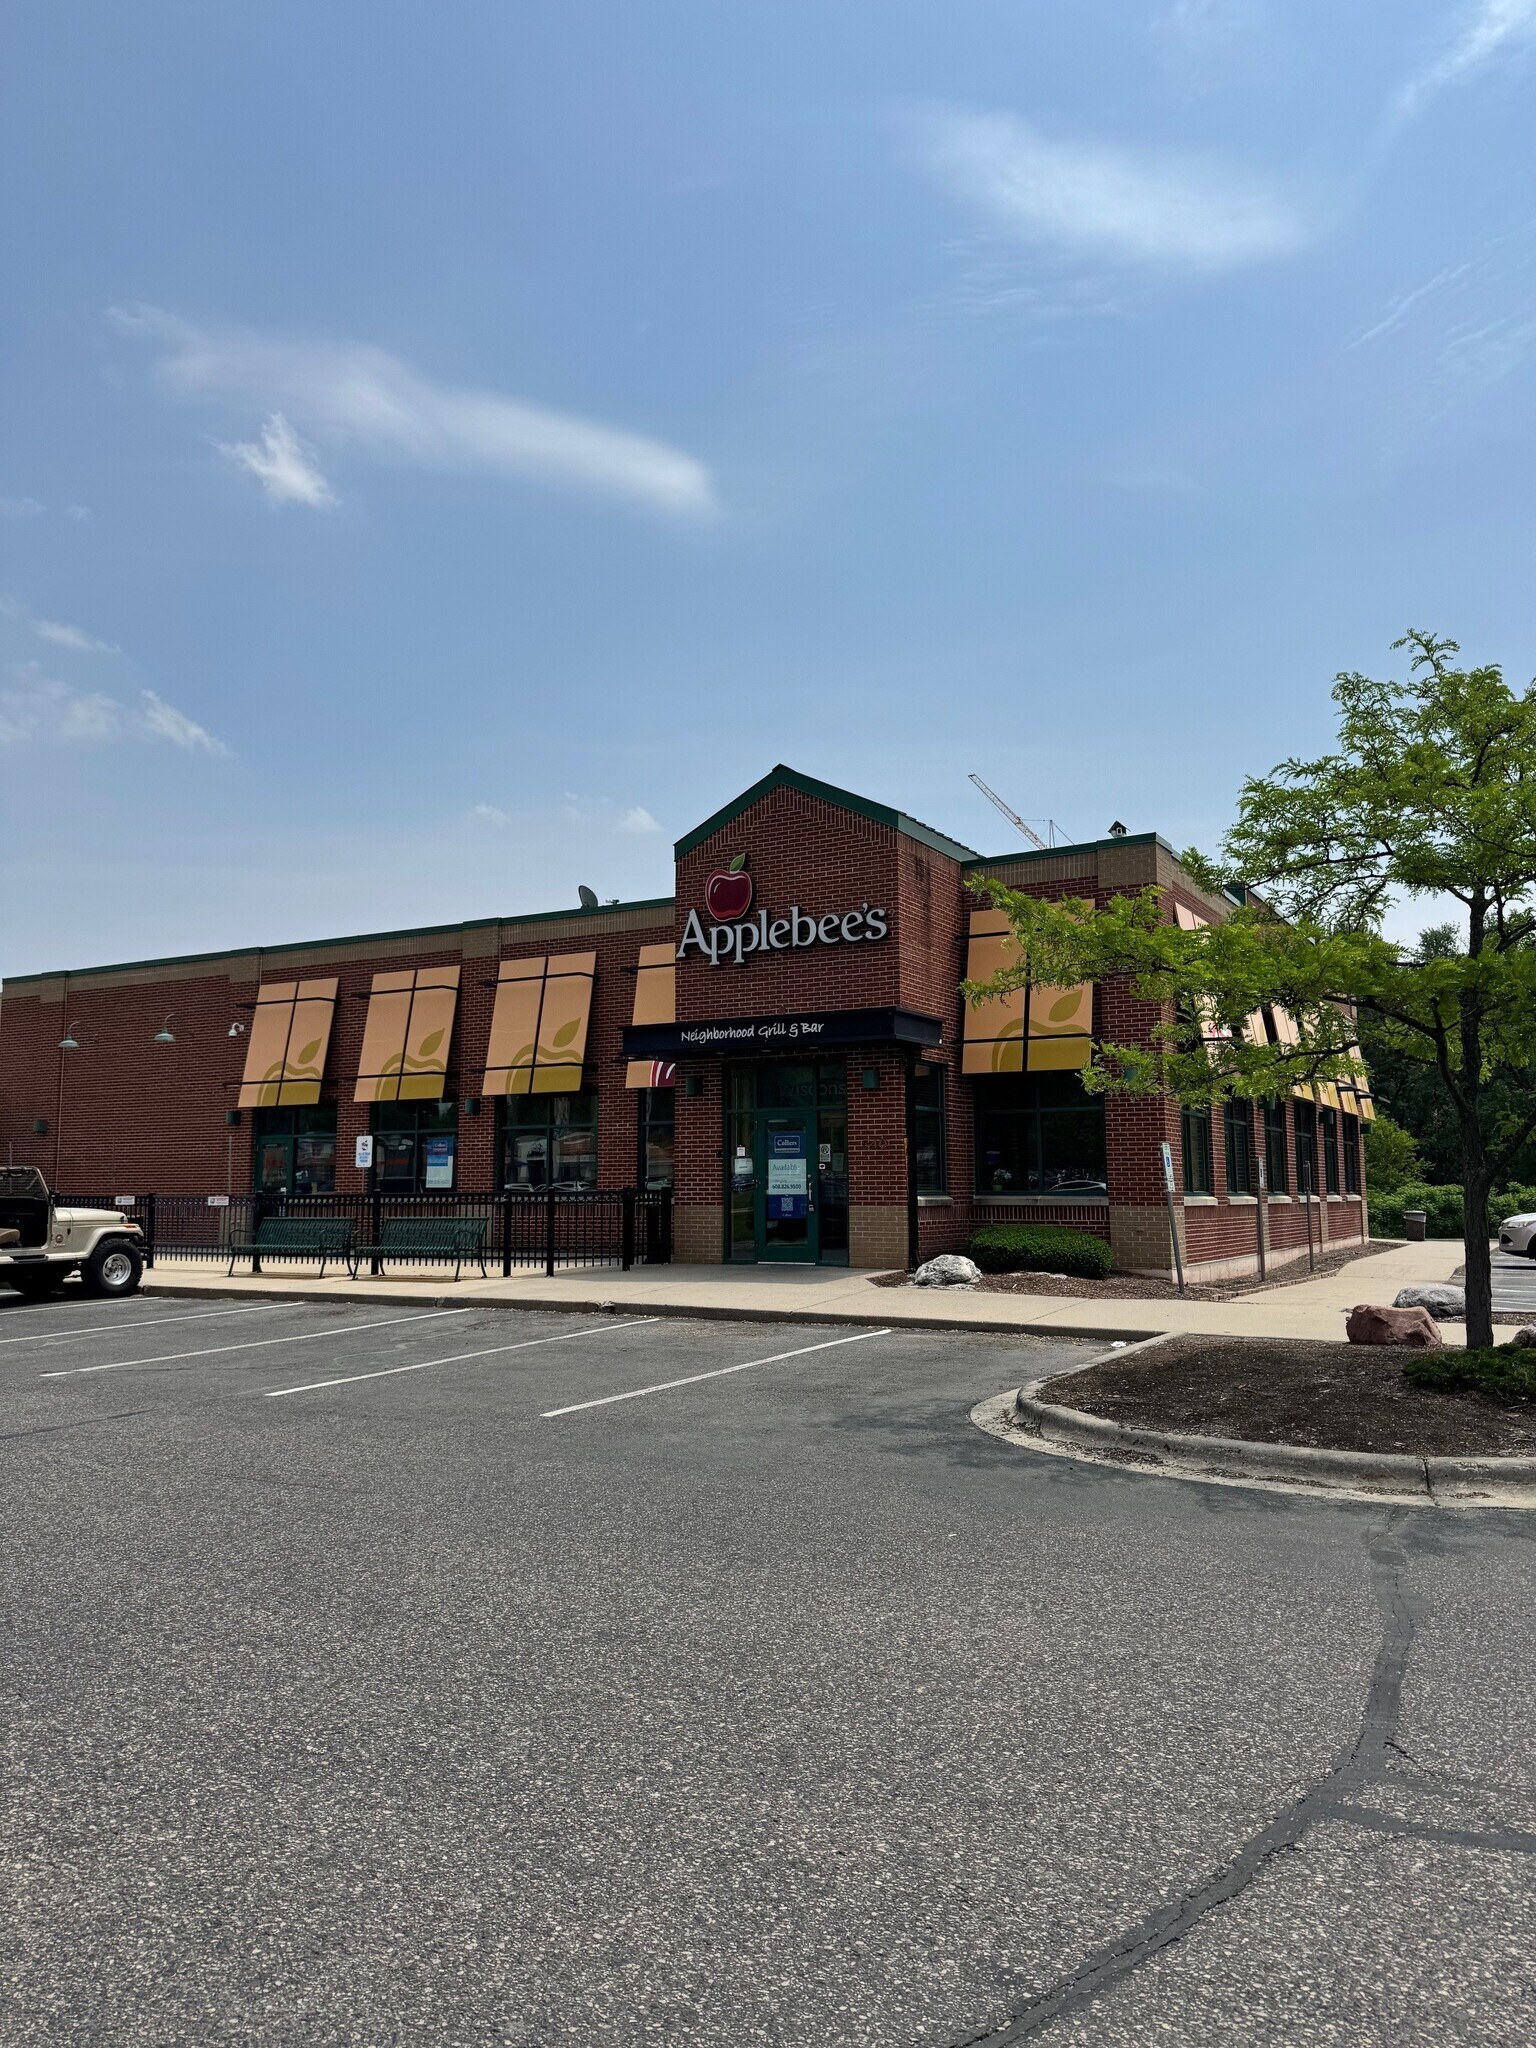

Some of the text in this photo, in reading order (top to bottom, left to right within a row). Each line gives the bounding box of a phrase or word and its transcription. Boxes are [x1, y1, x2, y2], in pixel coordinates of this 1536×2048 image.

[676, 902, 887, 965] Applebee's
[681, 1022, 824, 1044] Neighborhood Grill & Bar
